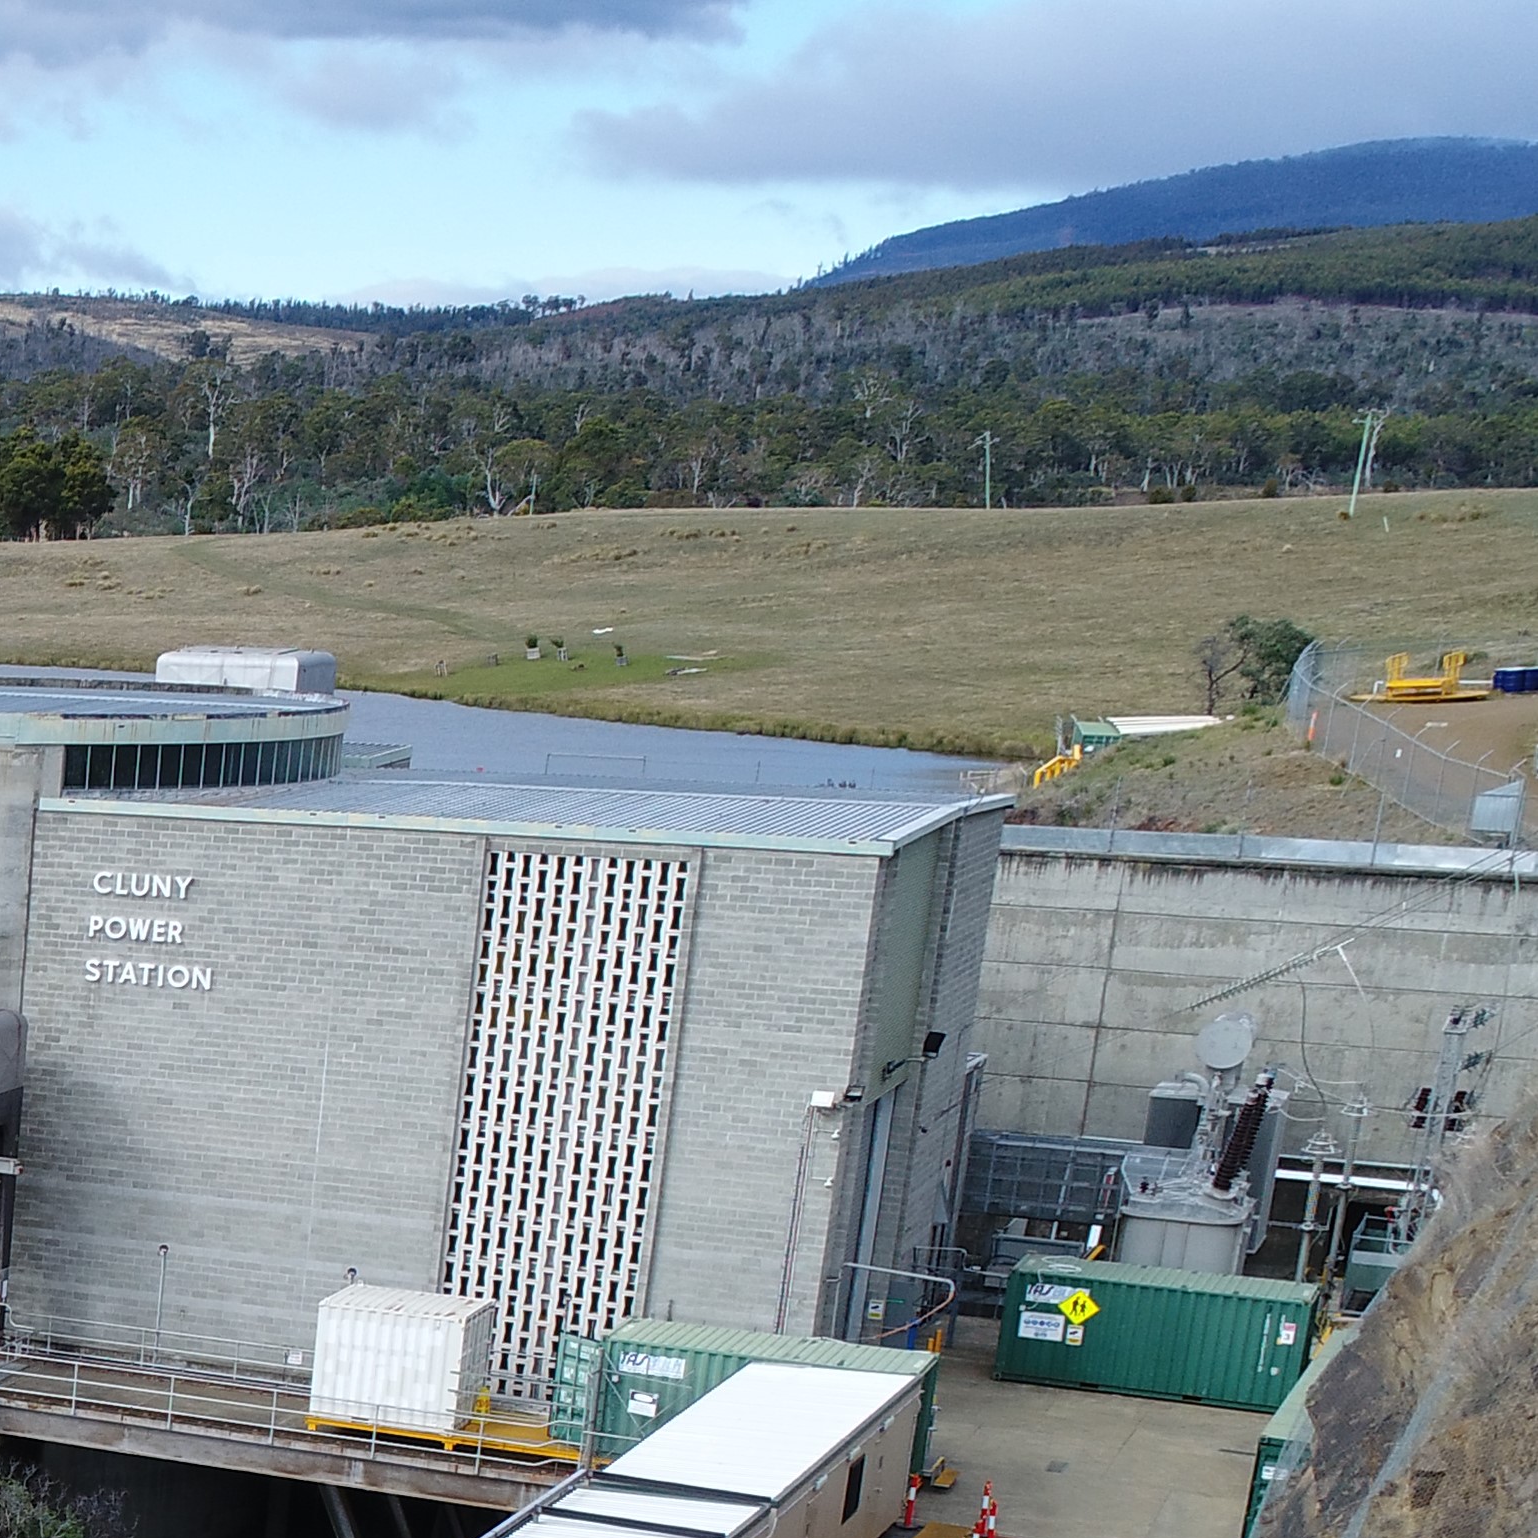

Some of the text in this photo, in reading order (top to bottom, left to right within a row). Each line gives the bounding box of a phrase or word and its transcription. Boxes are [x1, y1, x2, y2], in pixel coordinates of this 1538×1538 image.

[93, 871, 194, 899] CLUNY
[88, 915, 182, 943] POWER
[85, 959, 213, 990] STATION
